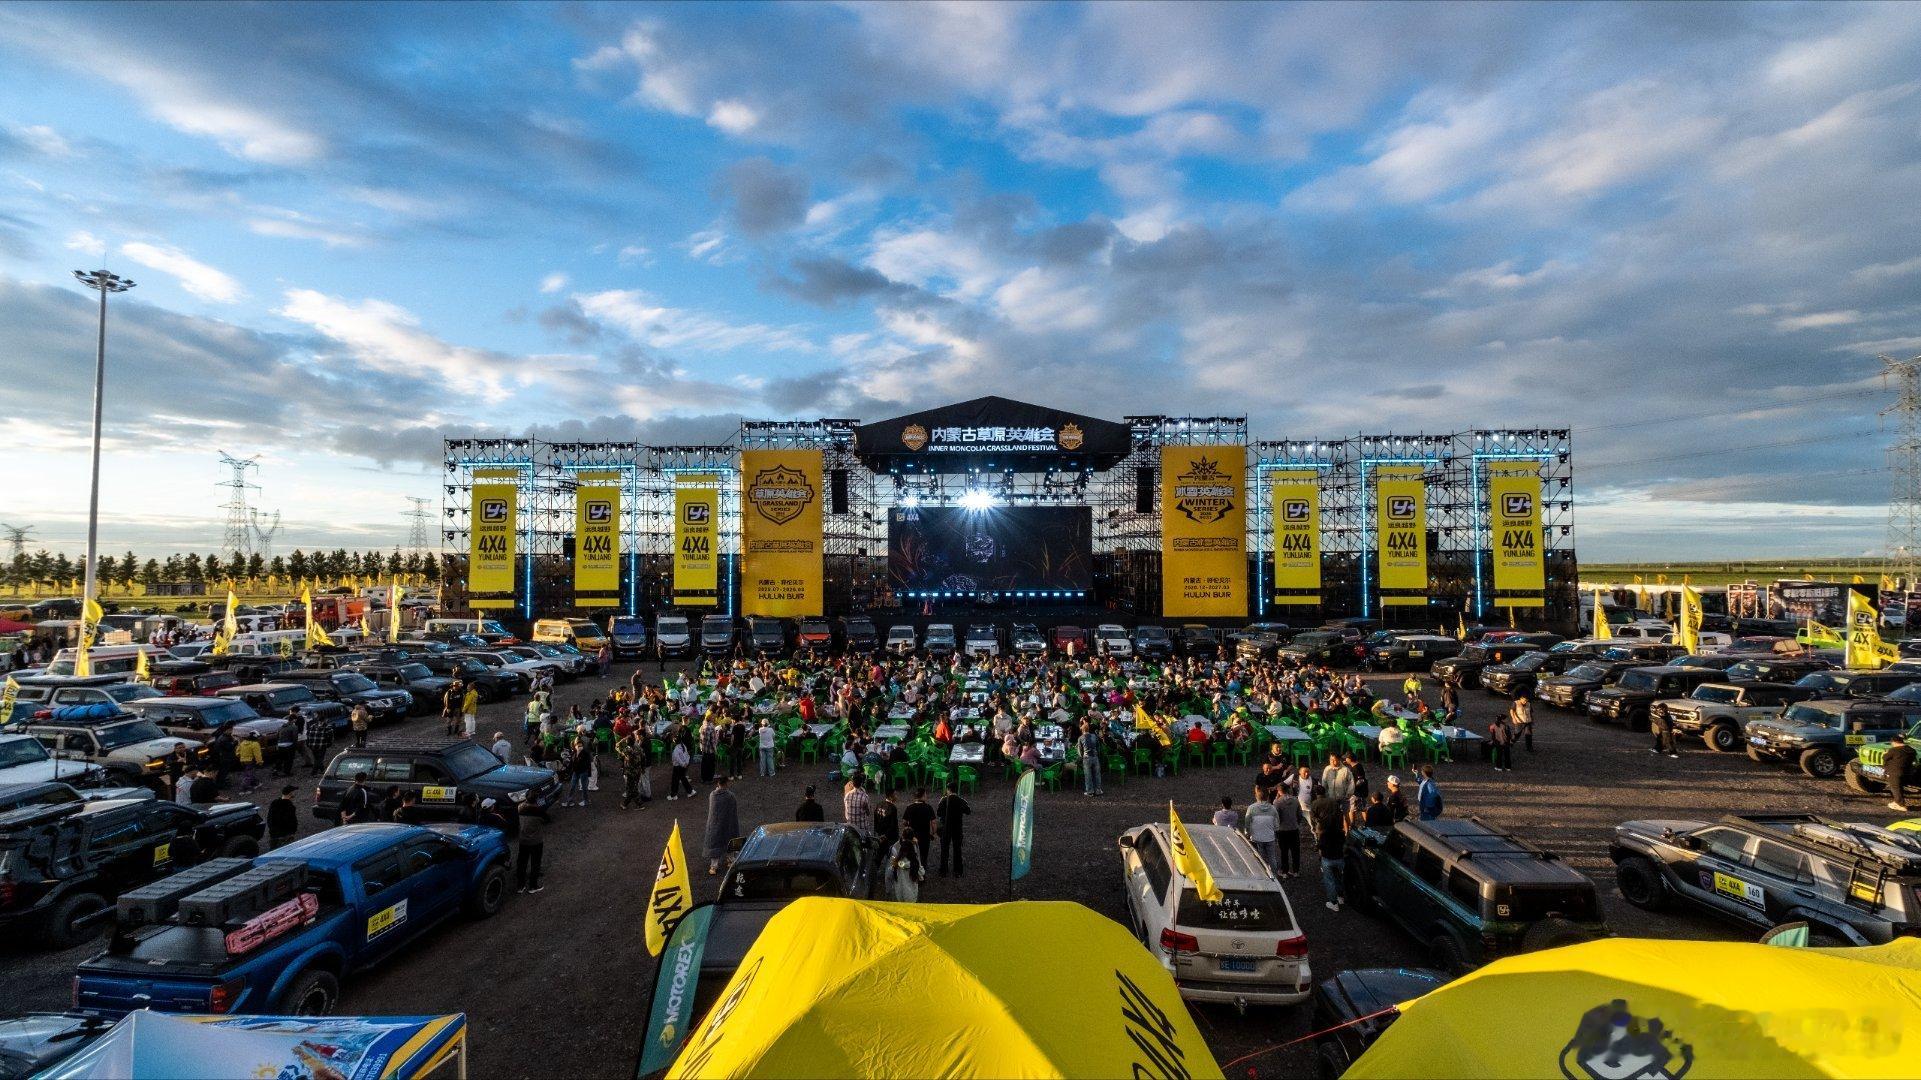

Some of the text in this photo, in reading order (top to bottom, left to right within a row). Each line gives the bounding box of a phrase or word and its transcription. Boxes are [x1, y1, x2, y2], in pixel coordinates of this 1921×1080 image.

[931, 427, 1055, 442] 内蒙古草原英雄会
[478, 535, 507, 553] 4X4
[583, 536, 611, 553] 4X4
[682, 537, 709, 553] 4X4
[1283, 534, 1311, 551] 4X4
[1388, 532, 1417, 550] 4X4
[1502, 531, 1534, 548] 4X4
[1016, 794, 1028, 849] MOTOREX
[664, 939, 695, 1024] MOTOREX
